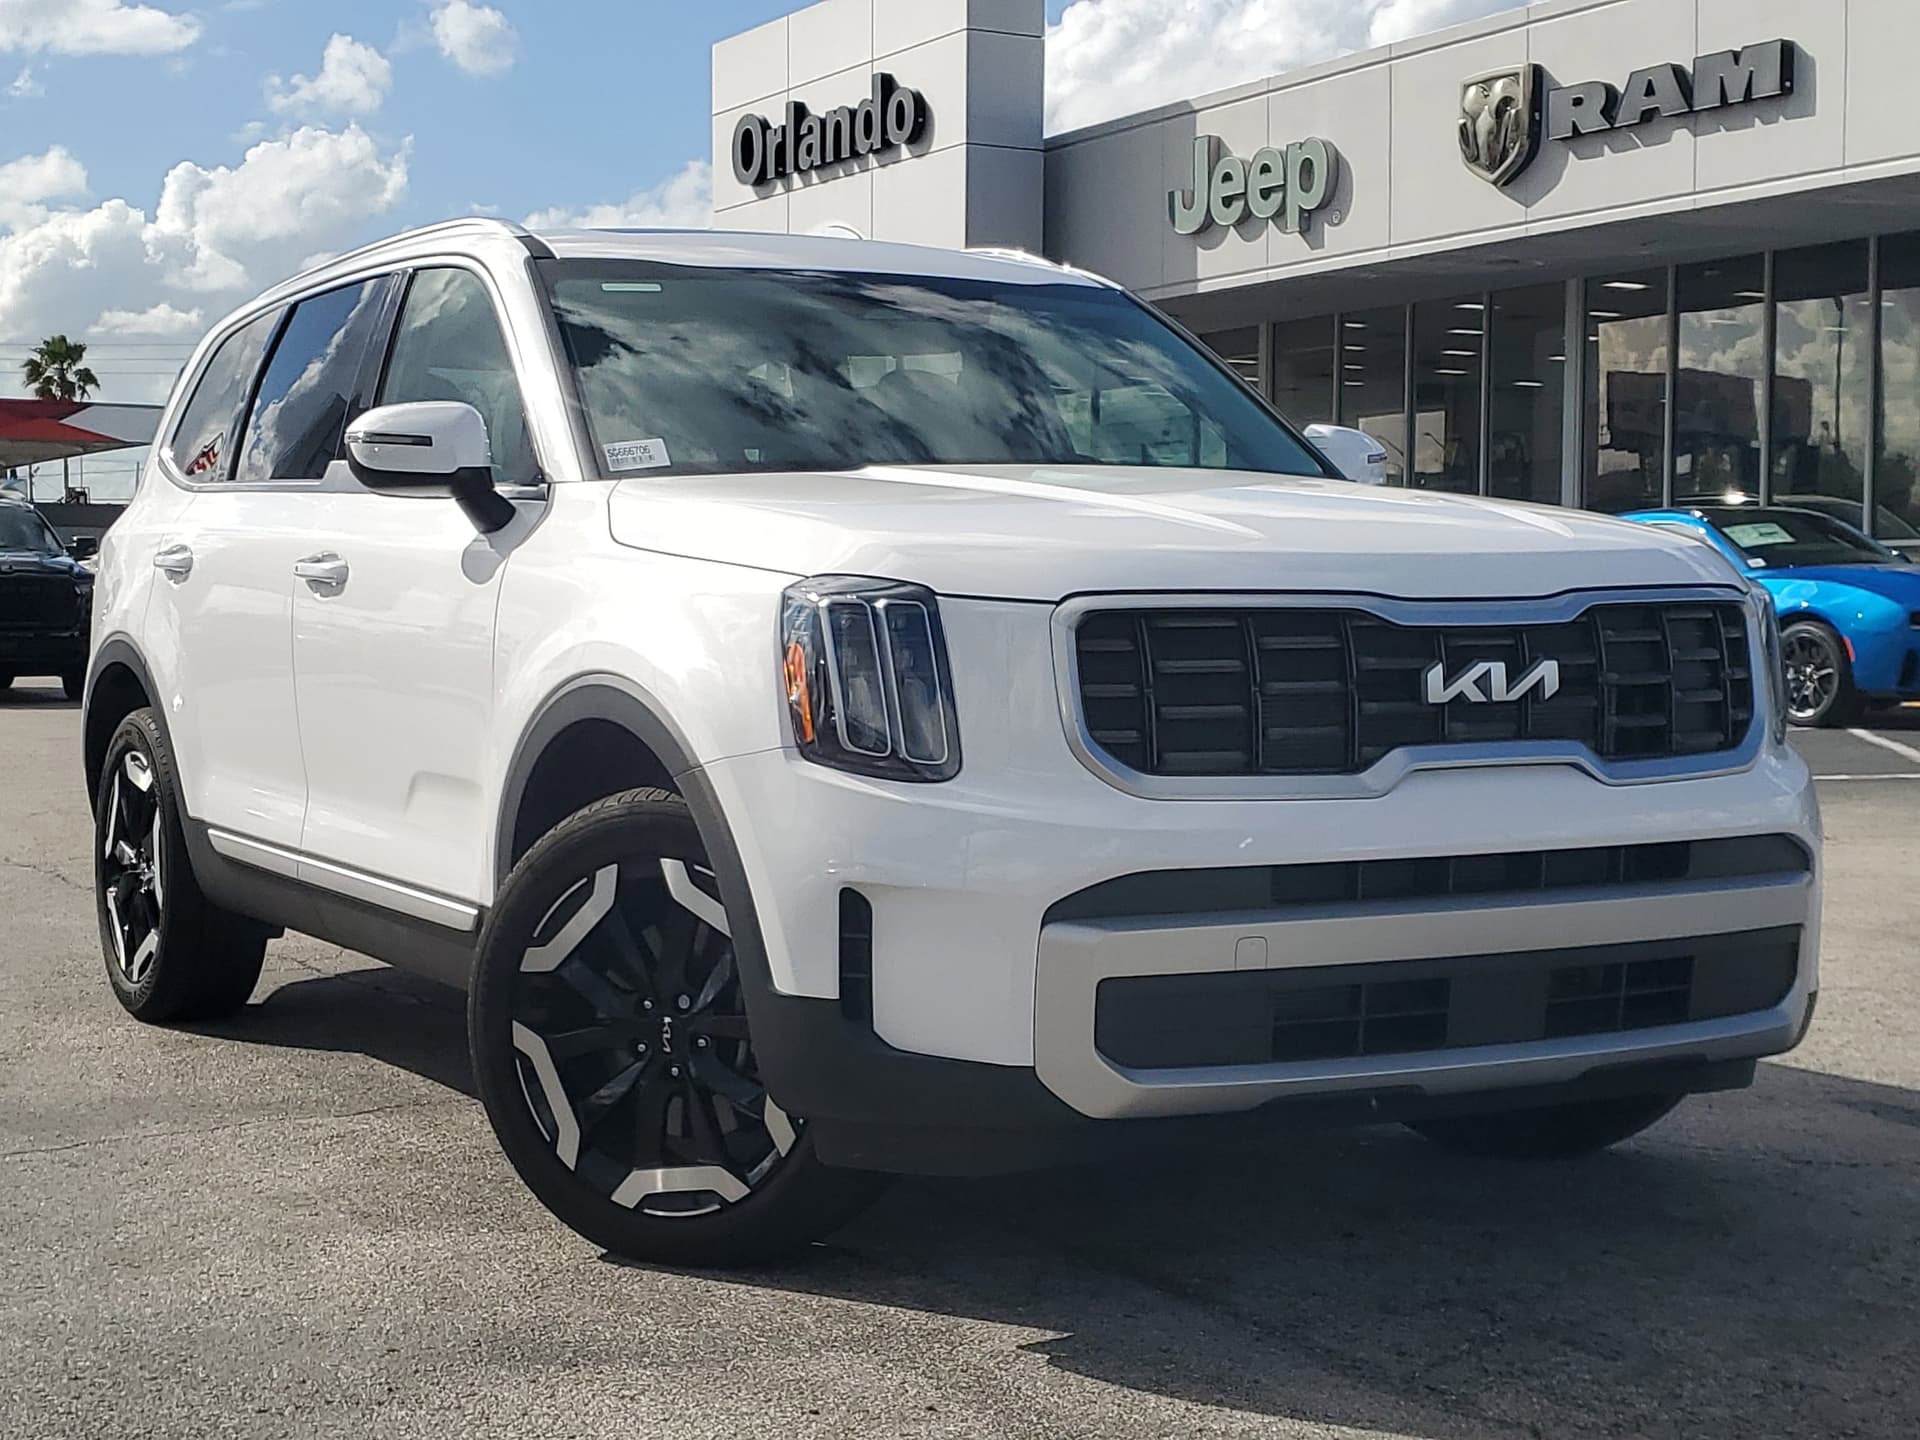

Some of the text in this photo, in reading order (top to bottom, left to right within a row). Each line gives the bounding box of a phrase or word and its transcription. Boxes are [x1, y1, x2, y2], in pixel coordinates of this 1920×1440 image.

[732, 72, 925, 186] Orlando
[1548, 38, 1793, 140] RAM
[1168, 134, 1338, 234] Jeep
[1427, 660, 1560, 703] KIA
